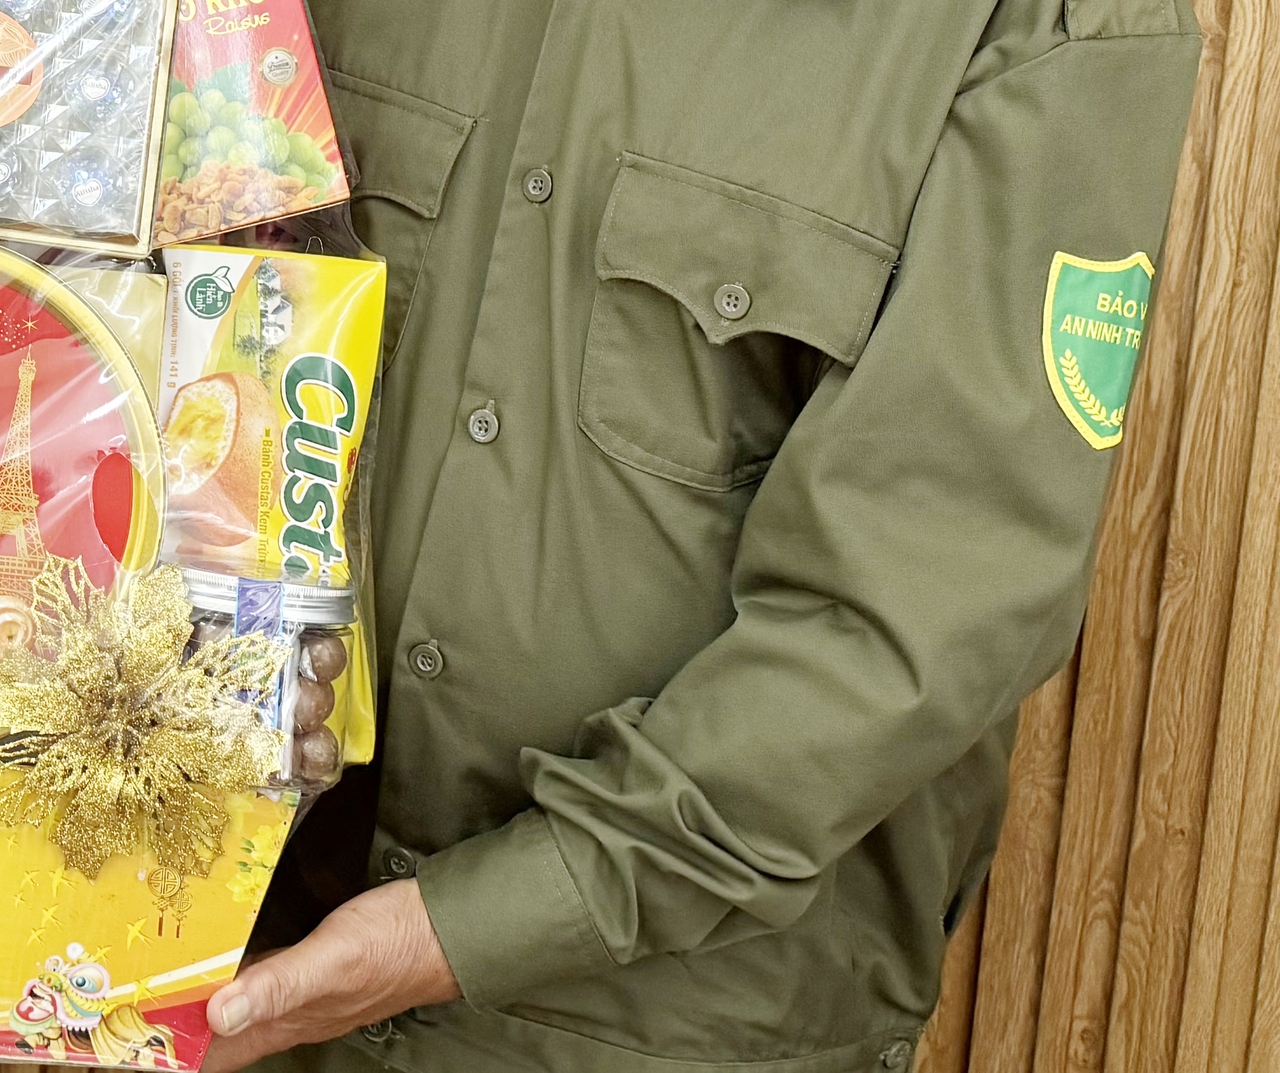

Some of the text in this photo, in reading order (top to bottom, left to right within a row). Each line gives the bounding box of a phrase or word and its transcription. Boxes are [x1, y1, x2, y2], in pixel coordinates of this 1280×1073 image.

[1096, 290, 1148, 321] BẢO V
[1059, 313, 1141, 350] AN NINH TR
[169, 360, 179, 379] 141
[261, 440, 274, 468] Bánh
[282, 354, 357, 578] Cust
[260, 469, 272, 512] Custas
[259, 512, 271, 537] Kem
